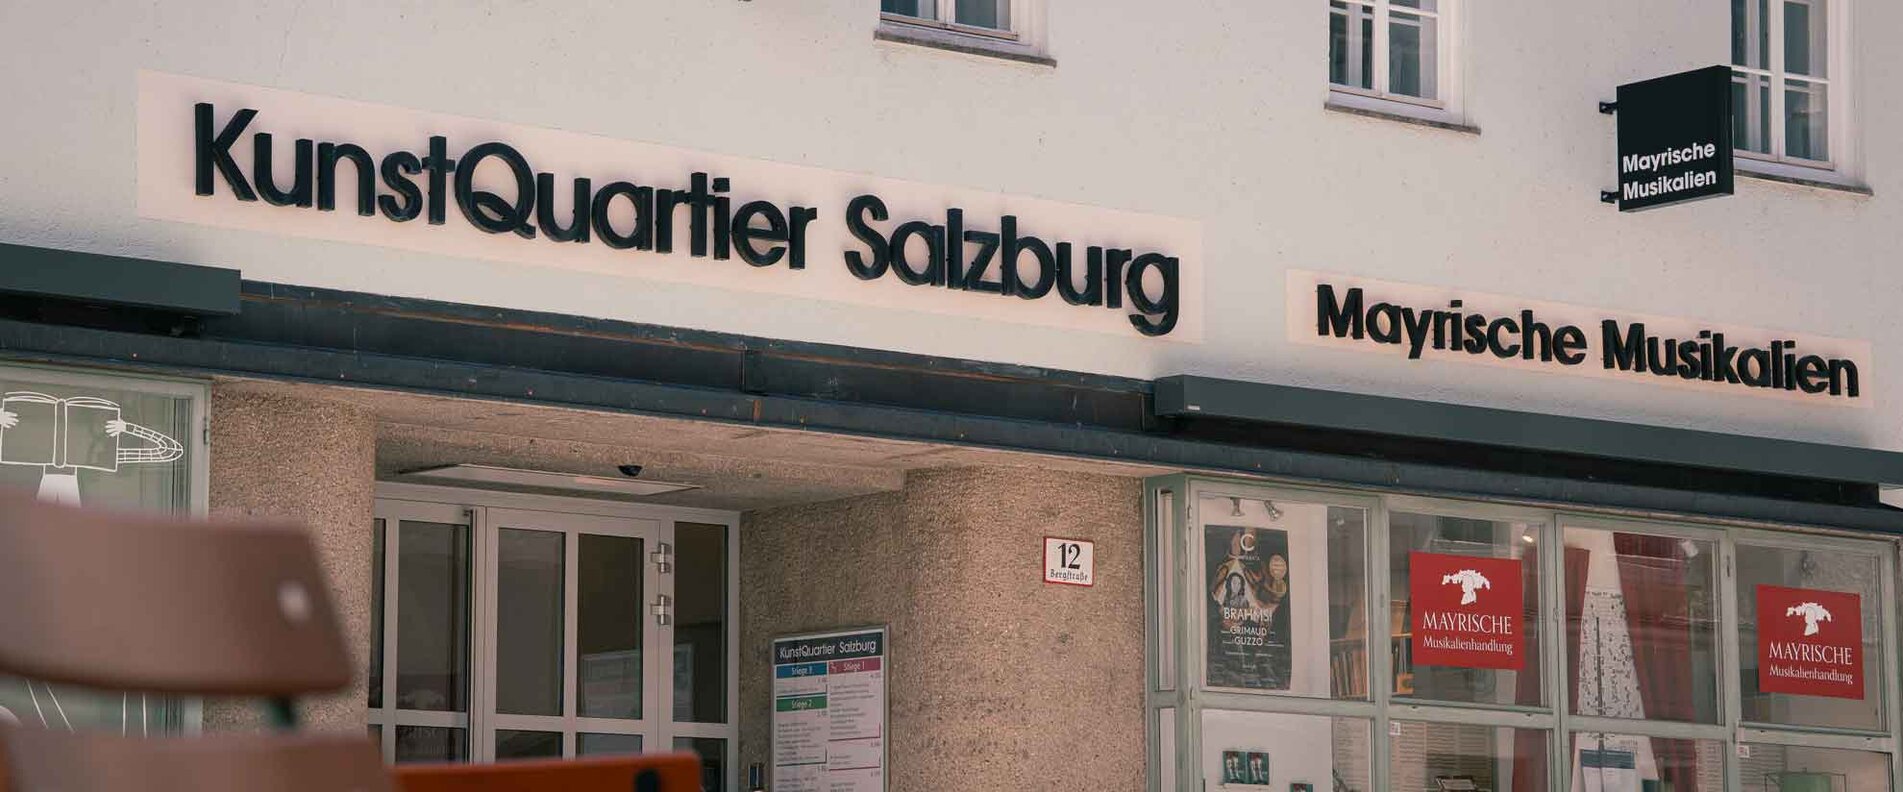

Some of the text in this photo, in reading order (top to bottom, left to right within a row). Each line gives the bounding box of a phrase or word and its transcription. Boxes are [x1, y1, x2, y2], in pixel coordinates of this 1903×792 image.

[1623, 142, 1716, 173] Mayrische
[1623, 170, 1717, 200] Musikalien
[195, 102, 1179, 336] KunstQuartier Salzburg
[1316, 284, 1859, 397] Mayrische Musikalien
[1057, 543, 1081, 569] 12
[1230, 626, 1267, 636] GRIMAUD
[1423, 611, 1512, 635] MAYRISCHE
[780, 640, 877, 659] KunstQuartier Salzburg
[1234, 636, 1263, 646] GUZZO
[1423, 635, 1513, 655] Musikalienhandlung
[1769, 641, 1853, 665] MAYRISCHE
[843, 662, 861, 672] Stiege
[1769, 664, 1853, 685] Musikalienhandlung
